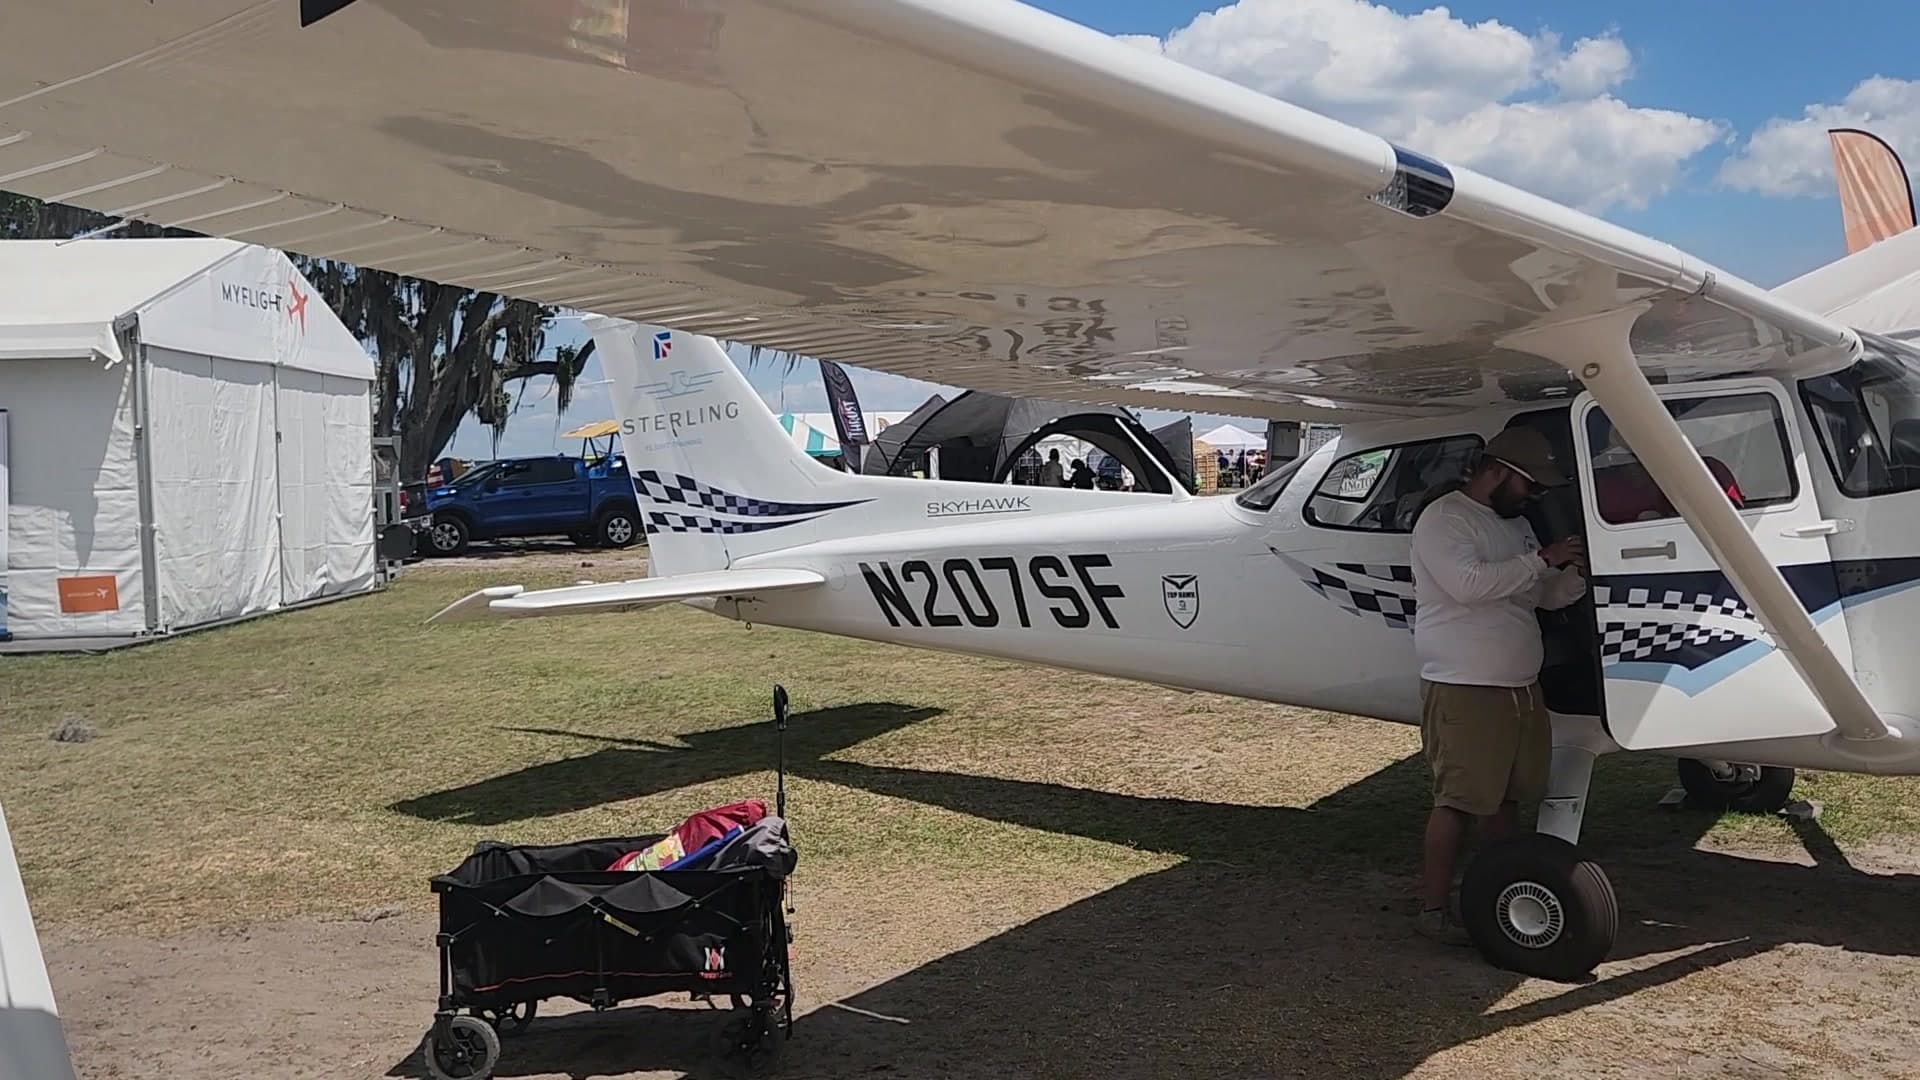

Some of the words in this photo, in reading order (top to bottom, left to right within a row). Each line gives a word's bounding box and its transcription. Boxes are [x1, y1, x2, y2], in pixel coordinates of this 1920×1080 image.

[221, 282, 282, 312] MYFLIGHT
[623, 402, 739, 435] STERLING
[842, 401, 865, 440] THRUST
[927, 496, 1031, 515] SKYHAWK
[858, 553, 1126, 629] N207SF
